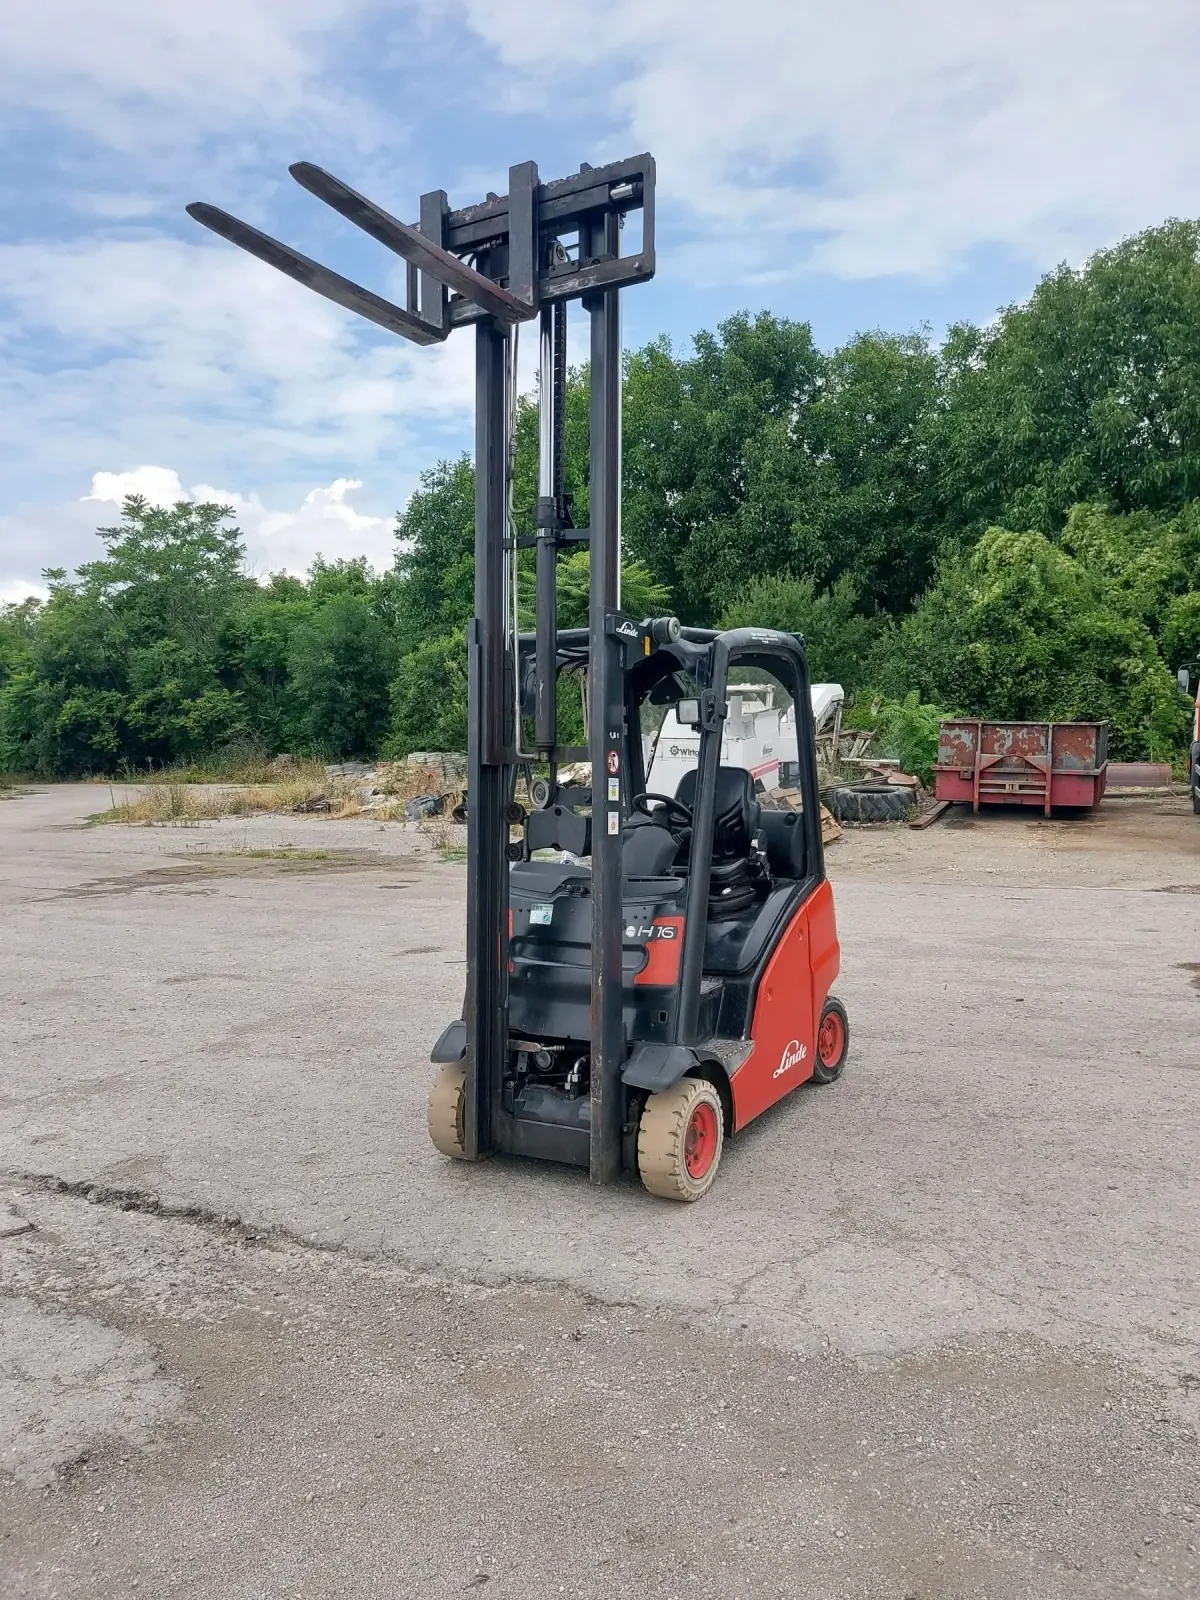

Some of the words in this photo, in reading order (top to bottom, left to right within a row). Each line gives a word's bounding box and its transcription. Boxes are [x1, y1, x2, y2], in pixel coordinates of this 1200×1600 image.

[616, 621, 638, 638] Linde
[637, 925, 654, 937] H
[657, 926, 674, 939] 16
[773, 1039, 807, 1079] Linde
